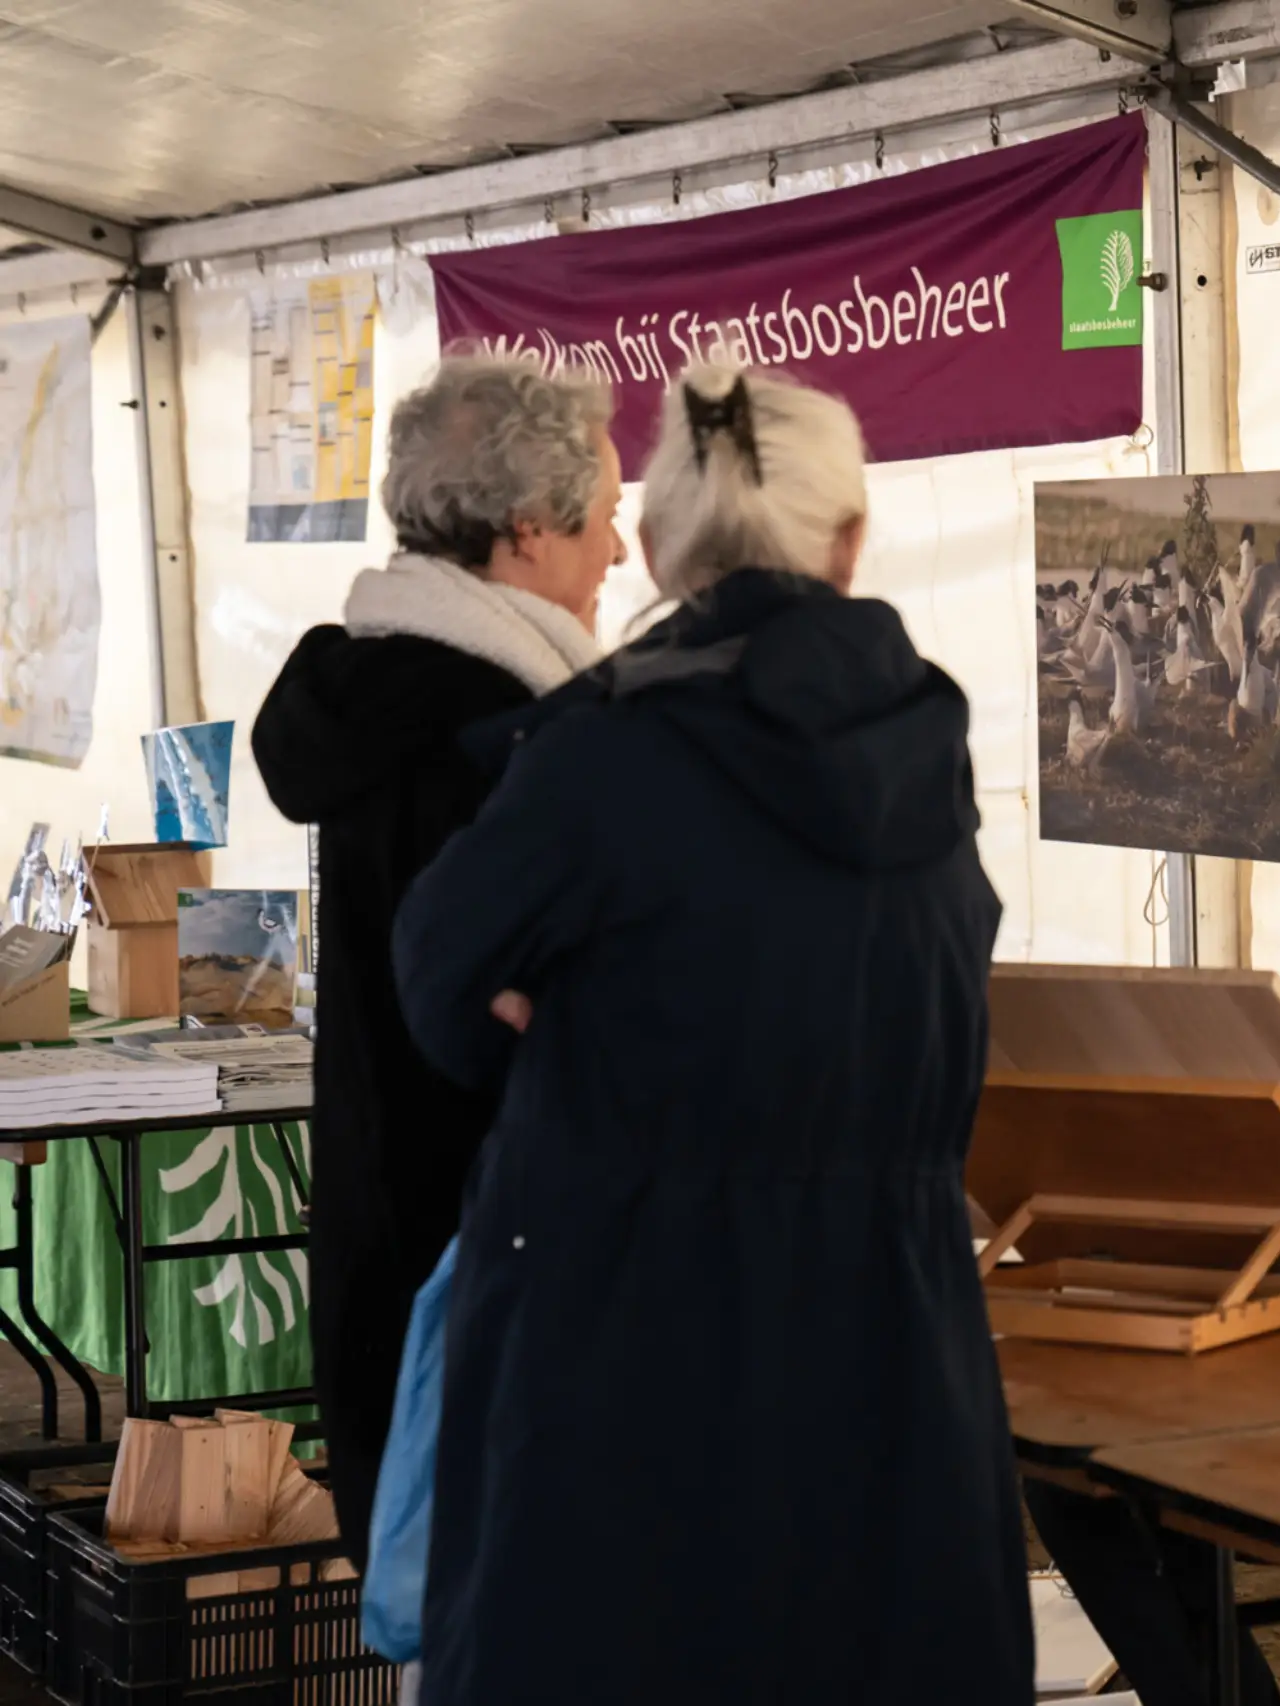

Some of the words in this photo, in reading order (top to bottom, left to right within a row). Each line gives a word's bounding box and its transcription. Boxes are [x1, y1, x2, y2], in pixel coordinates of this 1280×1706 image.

[616, 313, 671, 395] bij
[669, 266, 1009, 370] Staatsbosbeheer
[1069, 317, 1136, 332] staatsbosbeheer
